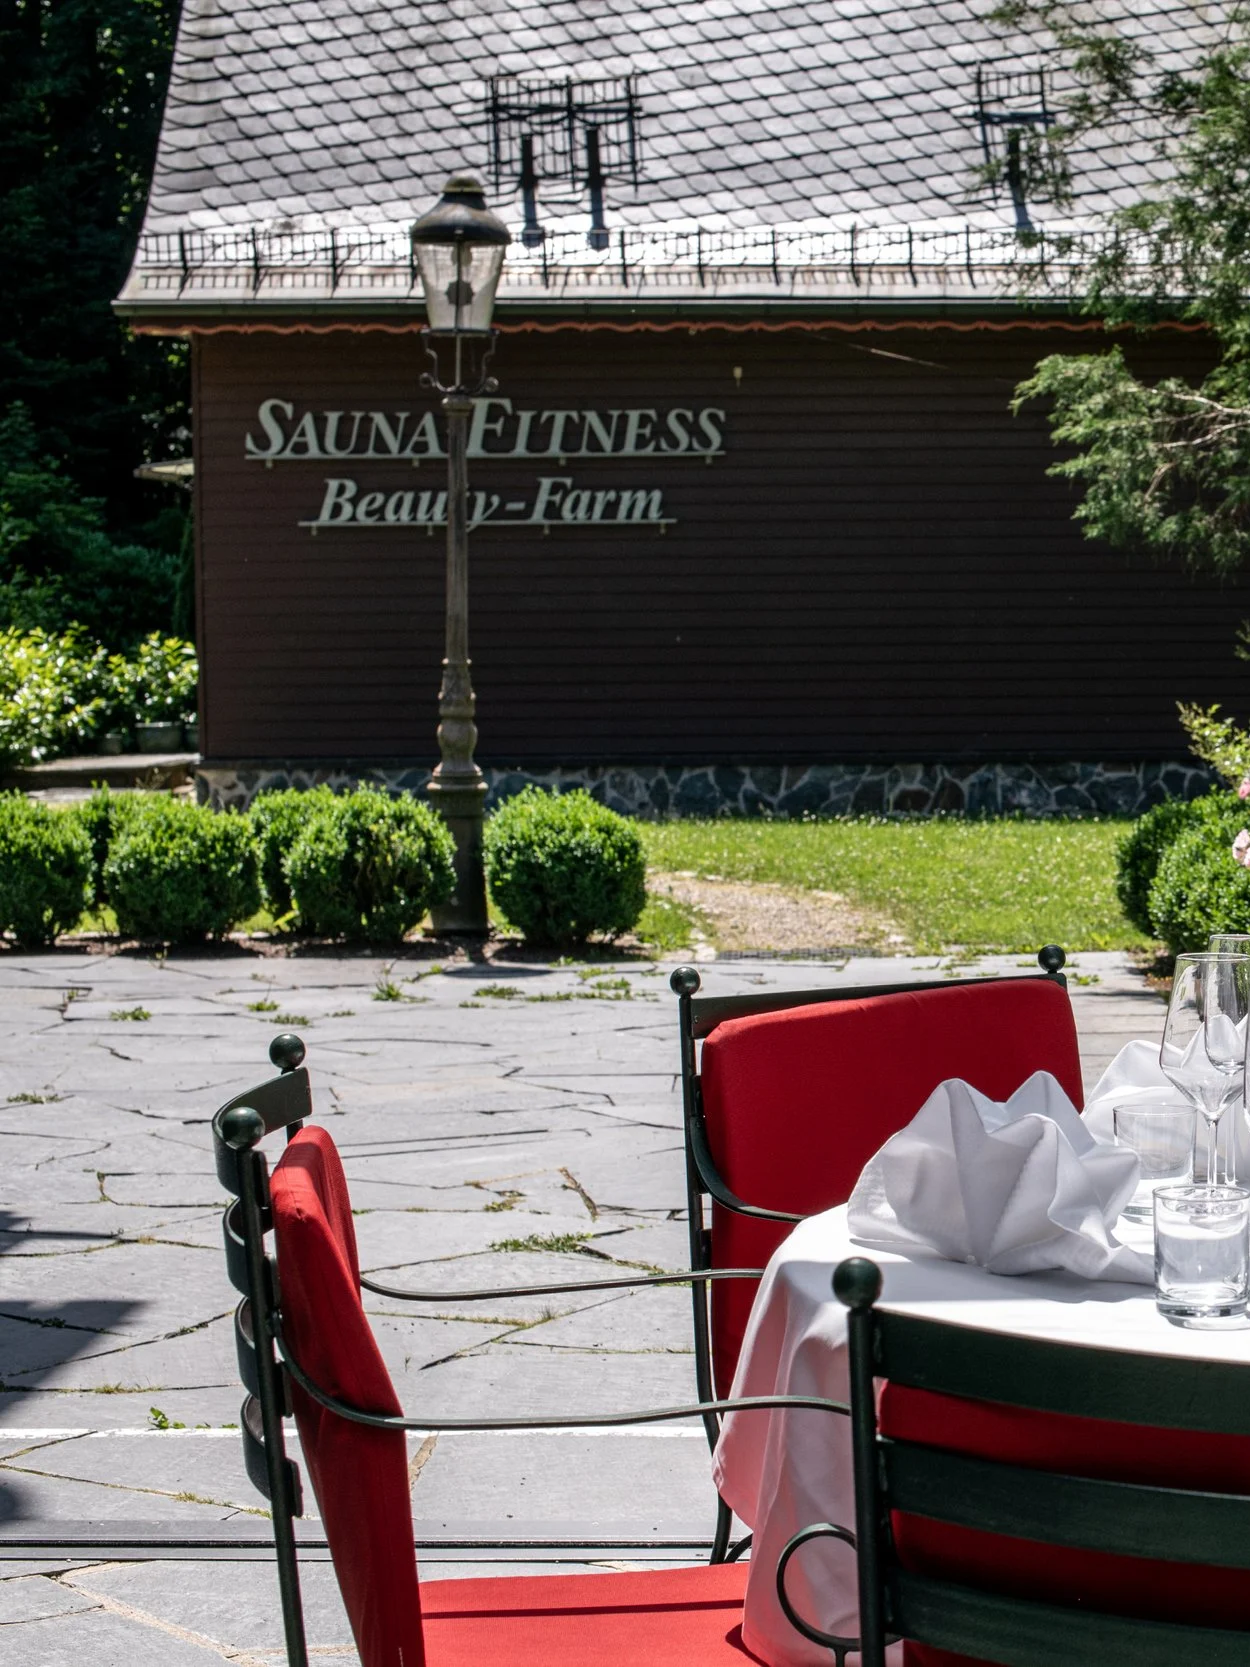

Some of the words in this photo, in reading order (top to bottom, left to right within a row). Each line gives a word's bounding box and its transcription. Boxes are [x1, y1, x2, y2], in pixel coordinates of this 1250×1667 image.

[245, 398, 449, 457] SAUNA
[466, 397, 726, 456] FITNESS
[319, 477, 664, 532] Beauy-Farm
